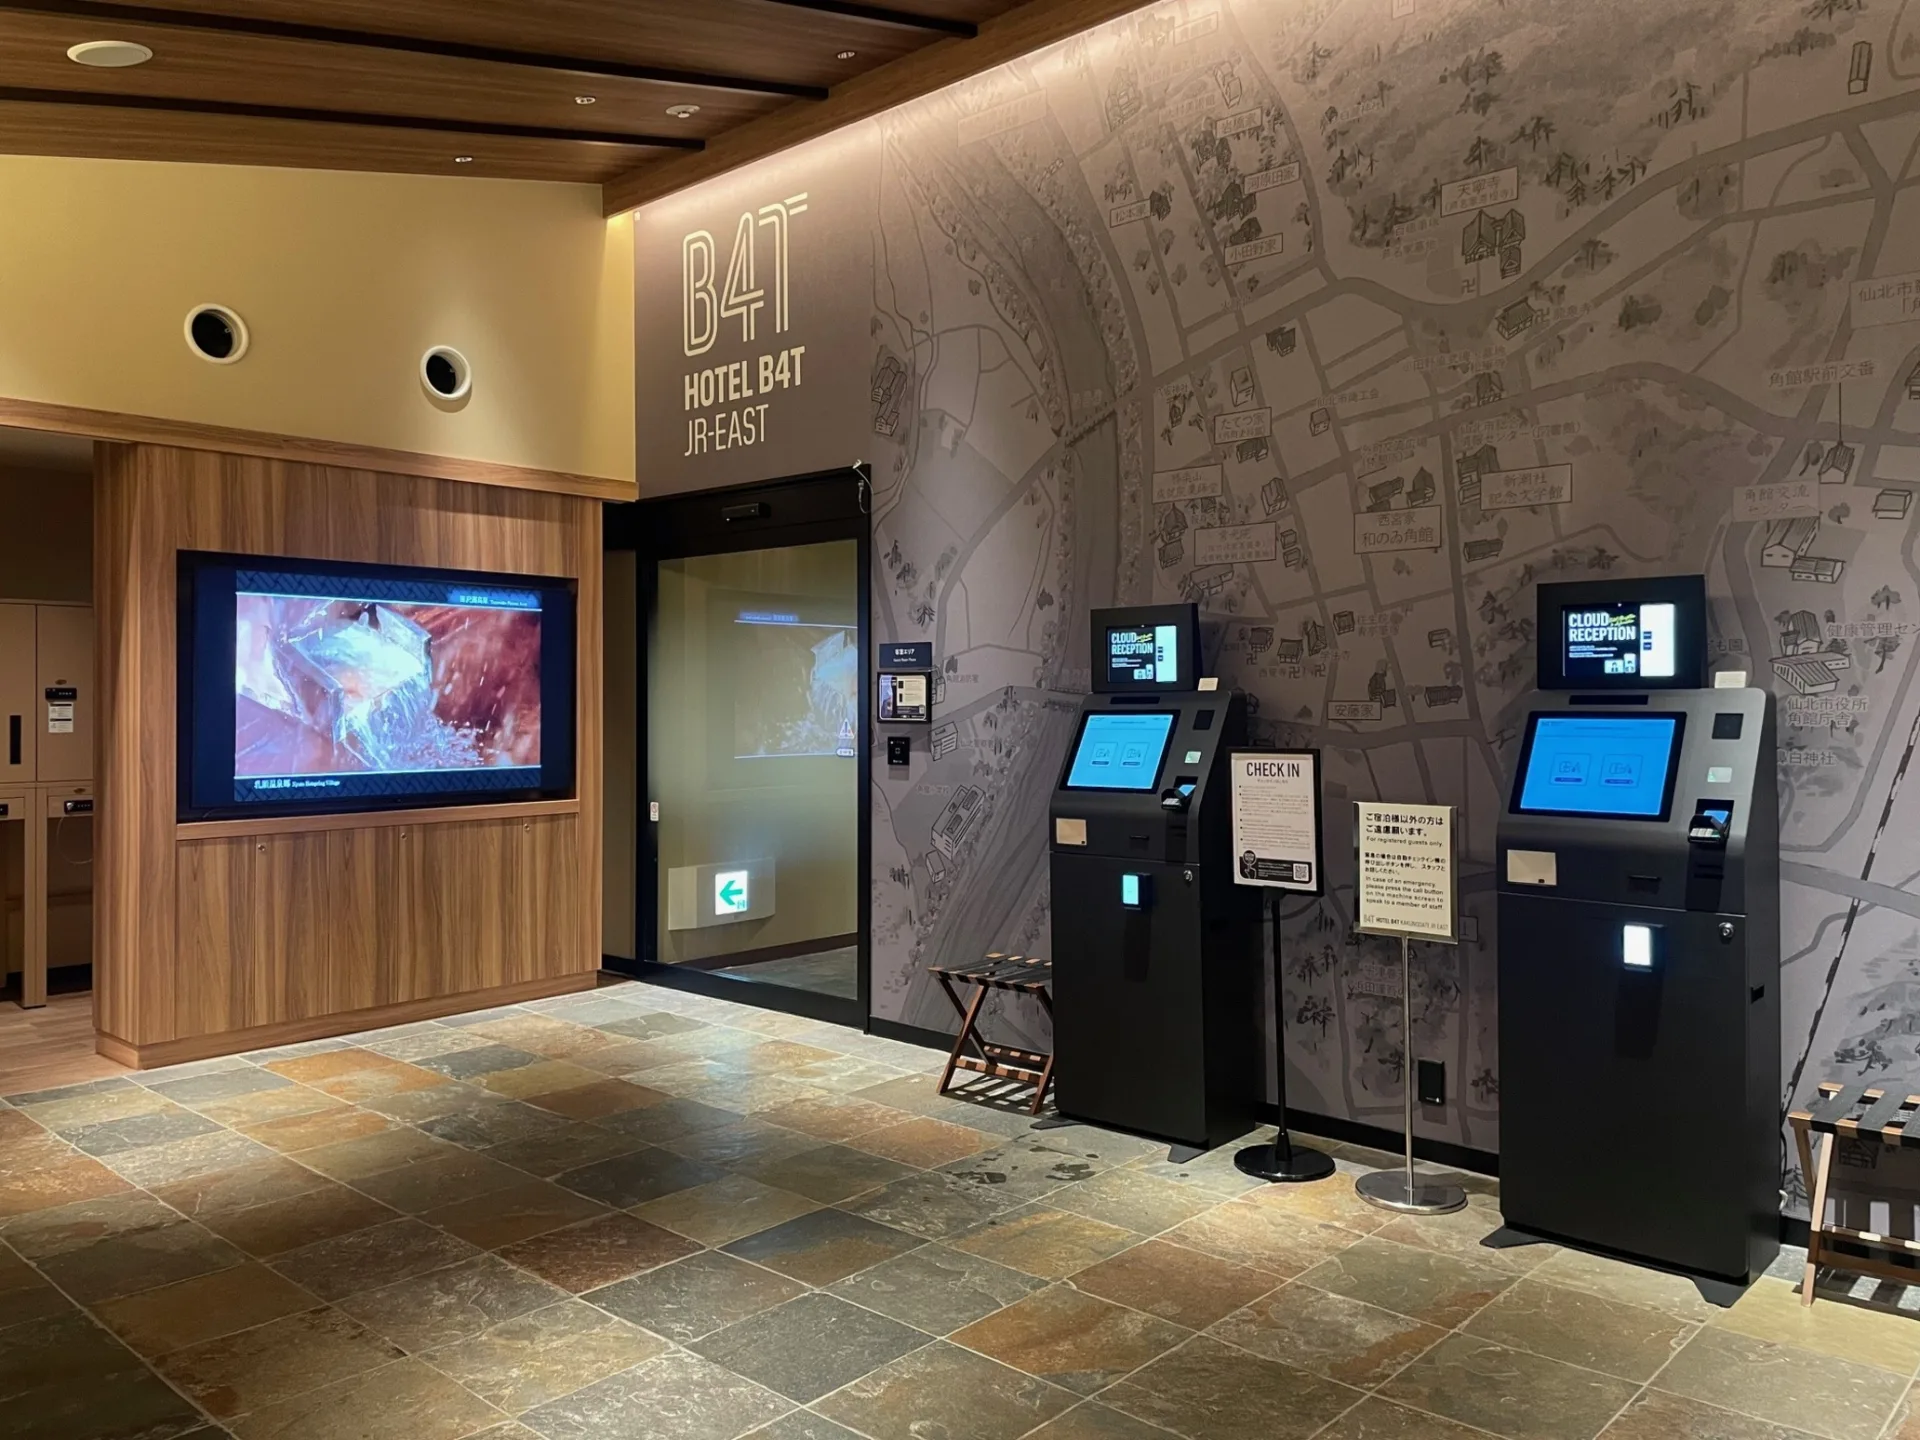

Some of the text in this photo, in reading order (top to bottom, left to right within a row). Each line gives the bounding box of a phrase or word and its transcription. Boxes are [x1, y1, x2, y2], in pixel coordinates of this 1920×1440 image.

[1230, 238, 1277, 261] 小田野家
[684, 345, 805, 411] HOTEL B4T
[1768, 359, 1877, 388] 角館駅前交番
[684, 404, 769, 456] JR-EAST
[1488, 485, 1564, 506] 記念文学館
[1568, 612, 1609, 627] CLOUD
[1111, 632, 1137, 643] CLOUD
[1568, 626, 1637, 642] RECEPTION
[1111, 643, 1154, 655] RECEPTION
[1334, 704, 1374, 718] 安藤家
[1787, 697, 1868, 711] 仙北市役所
[1788, 712, 1851, 726] 角館庁舎
[1246, 762, 1300, 778] CHECK IN
[1366, 812, 1444, 826] ご宿泊様以外の方は
[1366, 825, 1428, 837] ご遠慮願います。
[1386, 892, 1413, 900] machine
[1396, 900, 1420, 908] member
